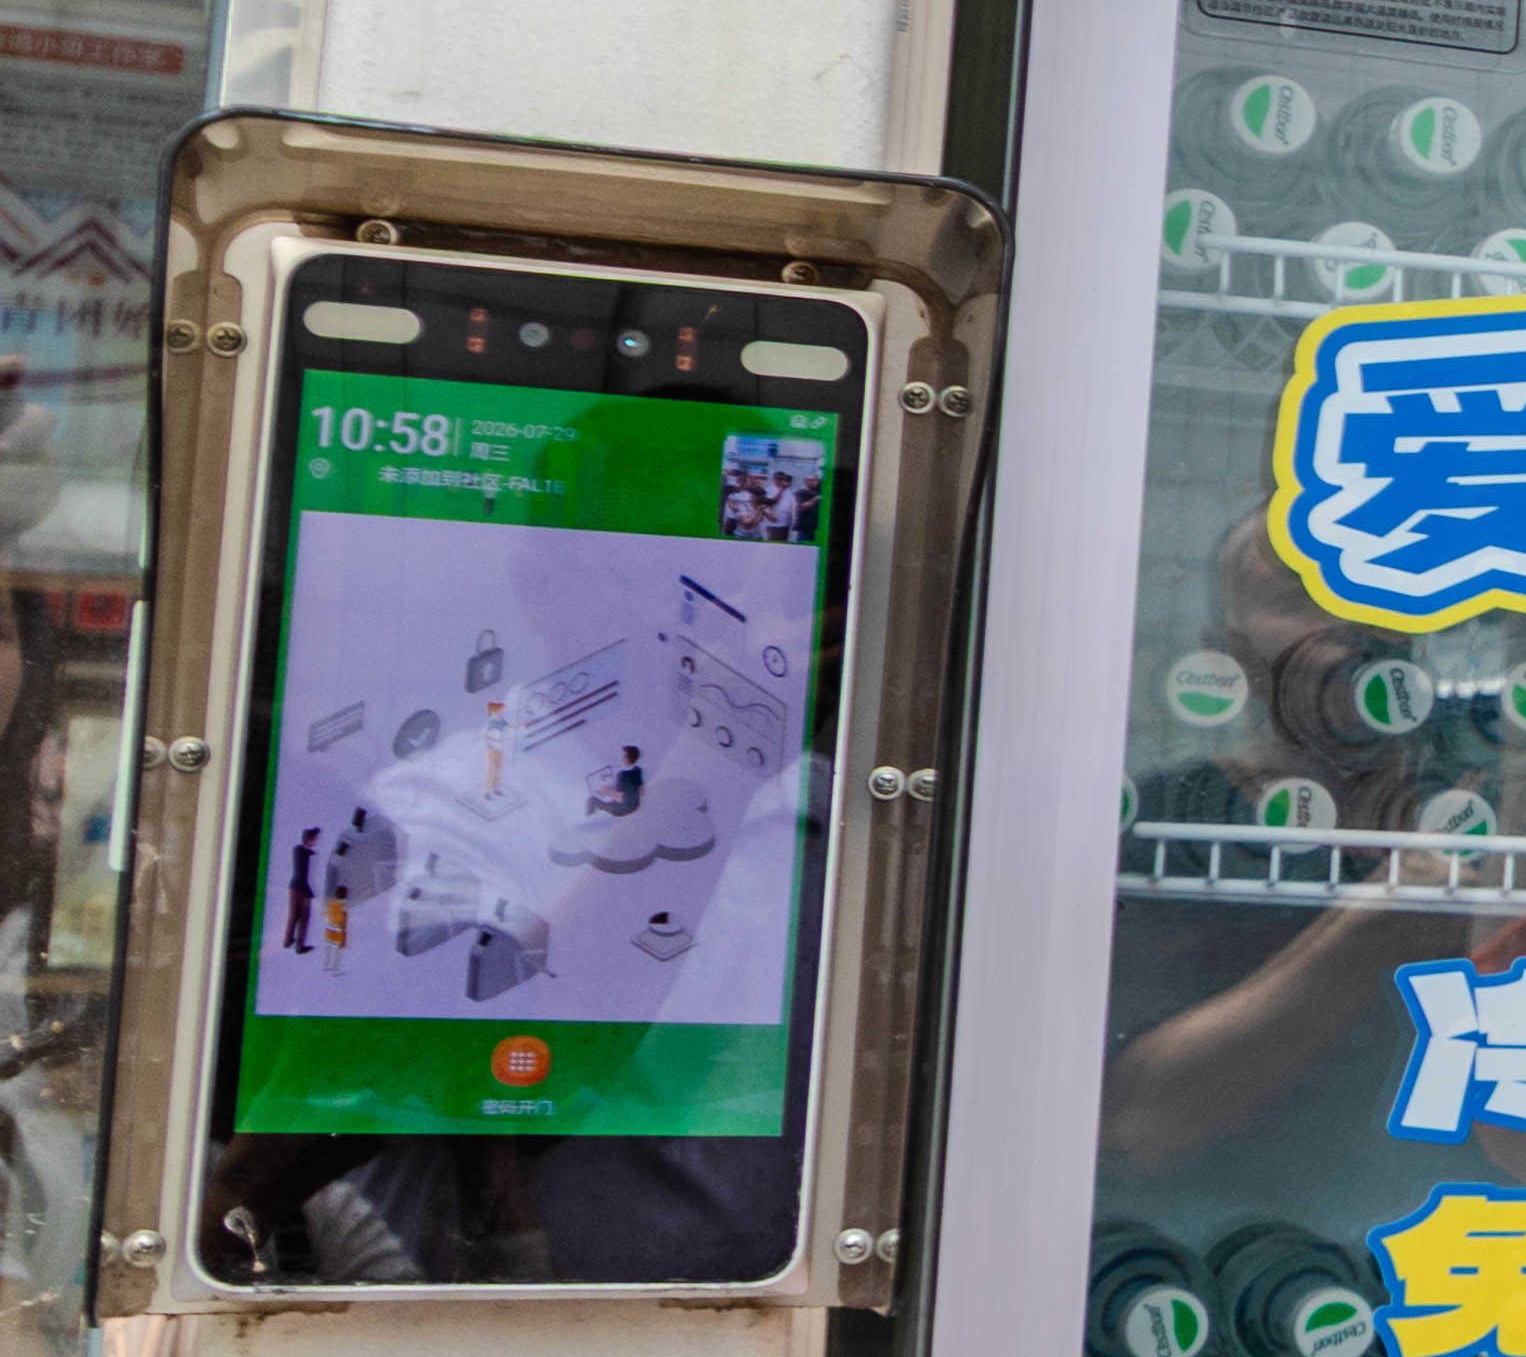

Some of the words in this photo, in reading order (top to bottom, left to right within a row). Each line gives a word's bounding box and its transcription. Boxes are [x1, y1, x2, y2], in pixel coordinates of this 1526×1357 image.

[310, 405, 450, 456] 10:58
[471, 417, 577, 443] 2026-07-29
[470, 444, 511, 462] 周三
